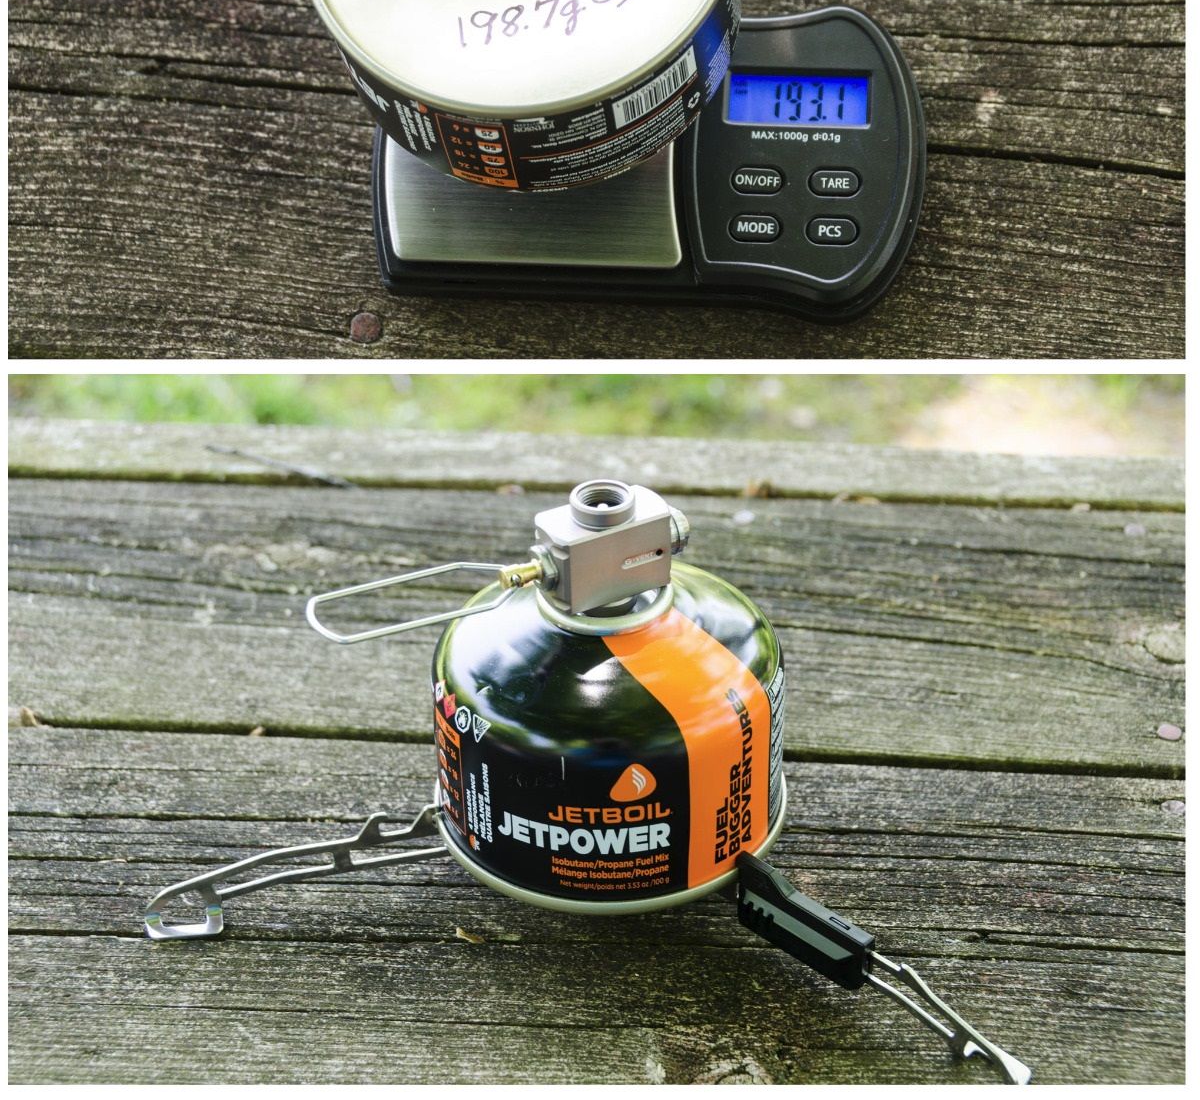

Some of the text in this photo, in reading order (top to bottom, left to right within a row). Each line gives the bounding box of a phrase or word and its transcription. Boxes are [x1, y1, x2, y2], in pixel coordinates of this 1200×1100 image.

[774, 81, 845, 122] 193.1
[751, 130, 809, 143] MAX:1000g
[734, 173, 781, 188] ON/OFF
[820, 177, 850, 190] TARE
[736, 220, 776, 235] MODE
[817, 224, 842, 238] PCS
[725, 688, 753, 843] ADVENTURES
[481, 762, 493, 843] QUATRE SAISONS
[728, 761, 741, 857] BIGGER
[548, 802, 672, 825] JETBOIL
[497, 811, 672, 855] JETPOWER
[714, 797, 729, 864] FUEL
[551, 853, 669, 869] Isobutane/Propane Fuel Mix
[551, 864, 669, 879] Mélange Isobutane/Propane
[573, 880, 615, 891] weight/poids
[627, 882, 641, 890] 3.53
